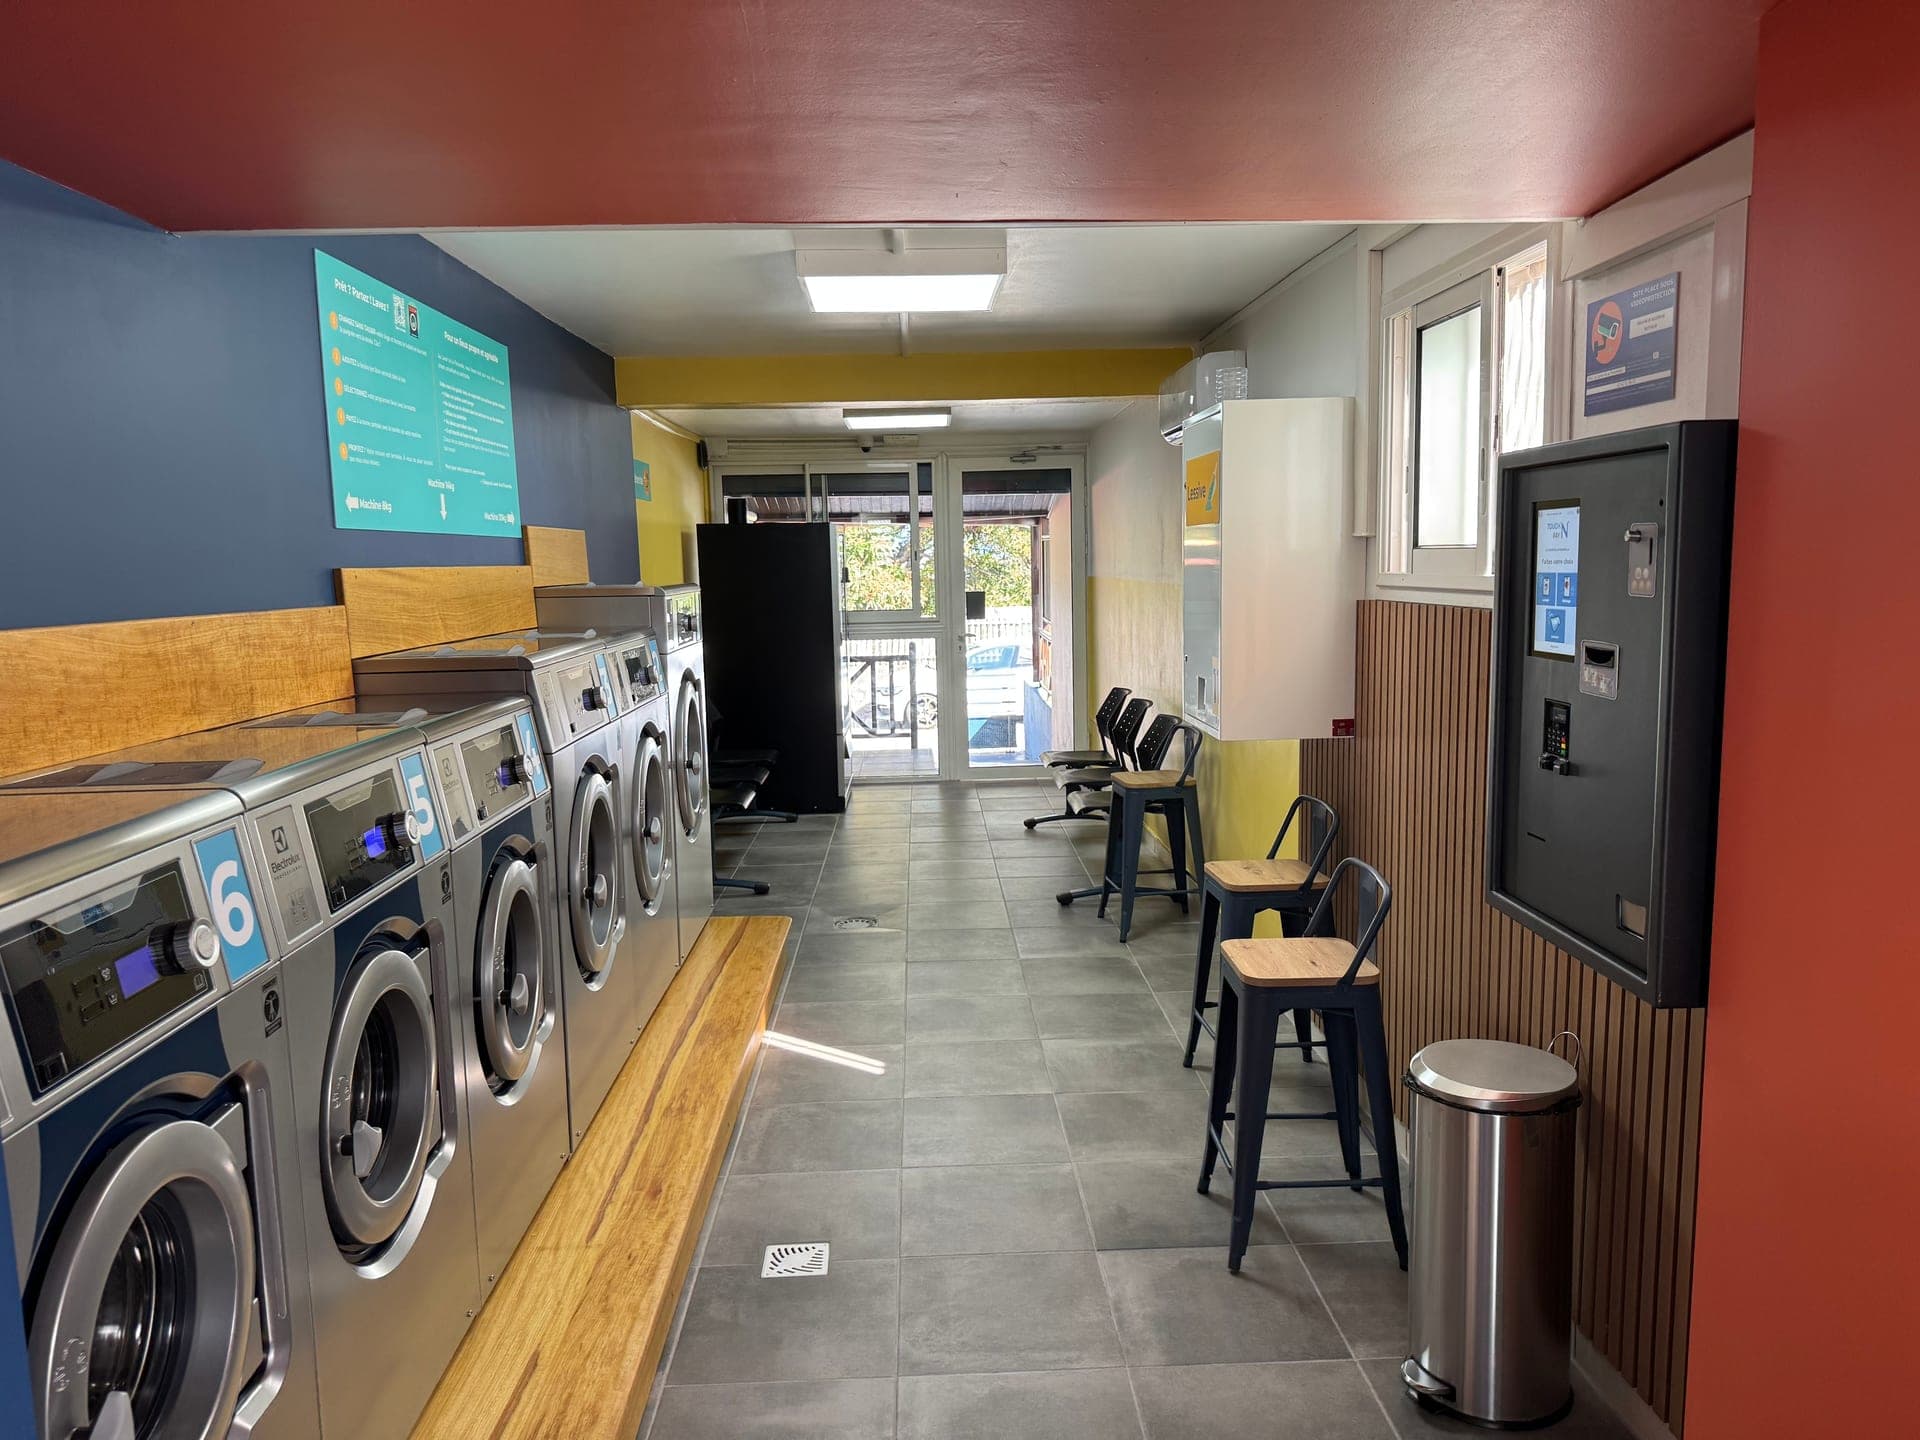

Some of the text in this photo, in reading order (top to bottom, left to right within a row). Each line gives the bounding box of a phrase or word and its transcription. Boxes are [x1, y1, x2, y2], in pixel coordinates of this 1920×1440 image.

[352, 286, 369, 304] Partez
[372, 296, 386, 311] Lavez
[1187, 482, 1206, 500] Lessive
[360, 498, 381, 510] Machine
[408, 774, 434, 836] 5
[271, 854, 301, 873] Electrolux
[211, 860, 254, 947] 6
